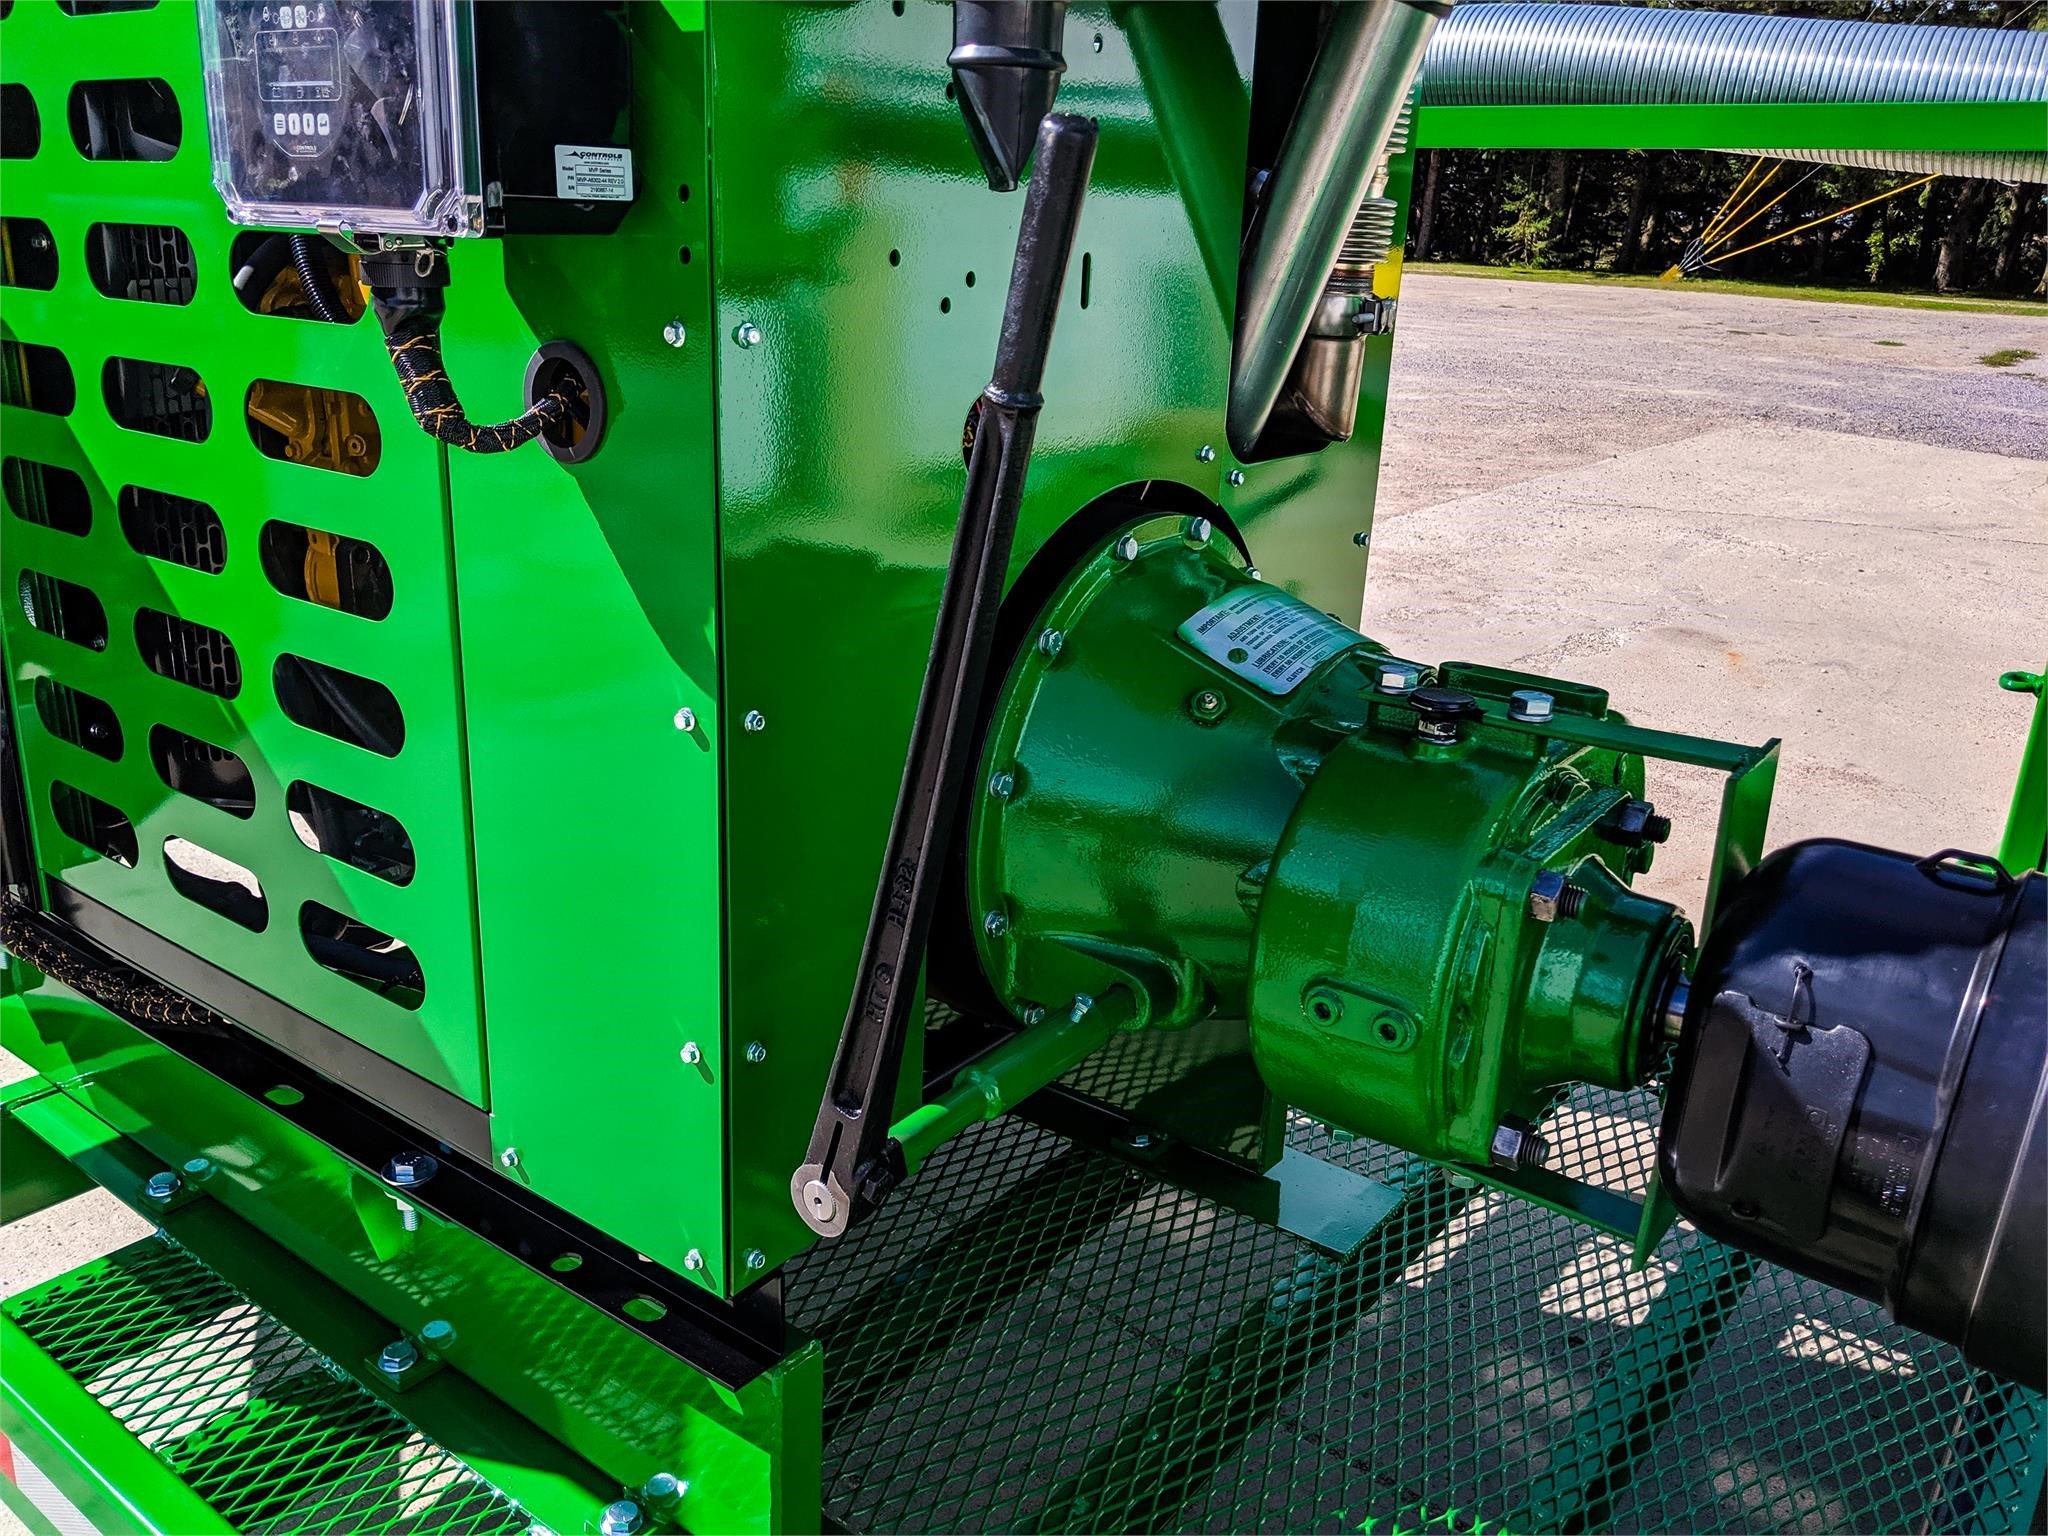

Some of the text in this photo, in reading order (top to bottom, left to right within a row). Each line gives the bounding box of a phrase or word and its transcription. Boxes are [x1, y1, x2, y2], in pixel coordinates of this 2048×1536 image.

[580, 151, 623, 159] CONTROLS
[1196, 609, 1228, 634] IMPORTANT:
[1227, 613, 1263, 642] ADJUSTMENT:
[1262, 659, 1278, 673] EVERY
[1270, 664, 1287, 678] EVERY
[1286, 666, 1306, 683] CLUTCH
